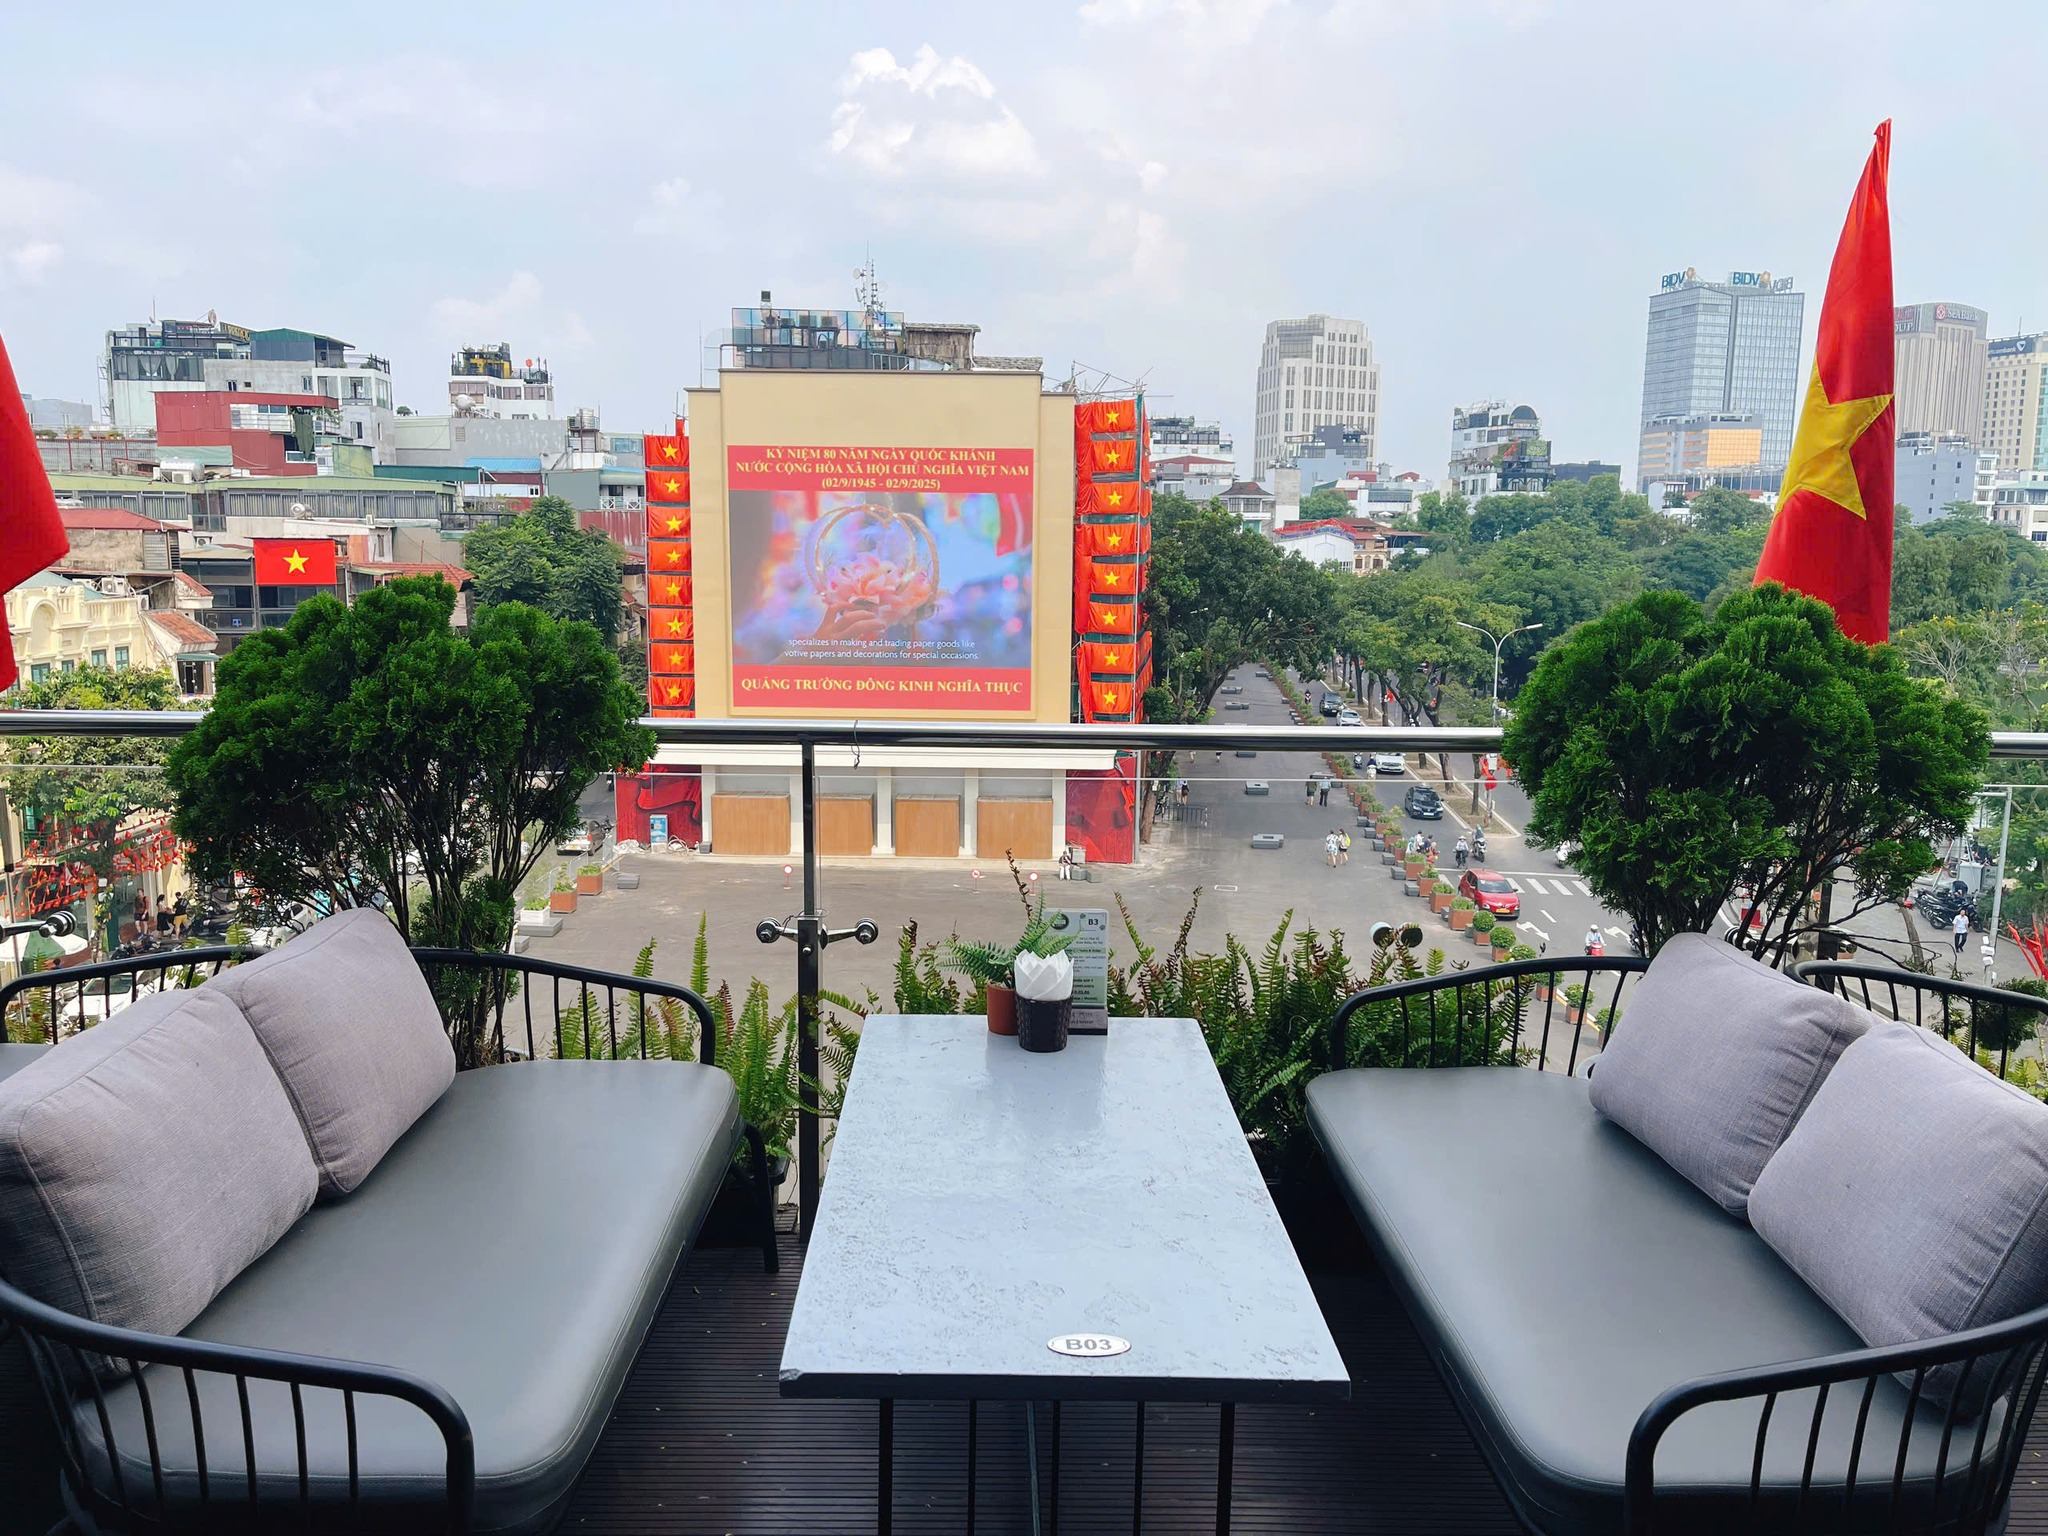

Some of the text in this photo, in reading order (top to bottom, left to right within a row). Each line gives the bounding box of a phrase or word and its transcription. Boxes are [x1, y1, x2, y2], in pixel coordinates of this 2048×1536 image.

[1661, 270, 1686, 289] BIDV
[1732, 271, 1760, 286] BIDV
[787, 447, 820, 461] NIỆM
[823, 448, 836, 459] 80
[839, 447, 868, 460] NĂM
[871, 447, 907, 460] NGÀY
[910, 448, 947, 463] QUỐC
[950, 448, 996, 461] KHÁNH
[736, 460, 772, 473] NƯỚC
[776, 461, 812, 475] CỘNG
[815, 460, 843, 474] HÒA
[846, 462, 863, 474] XÃ
[866, 462, 890, 476] HỘI
[923, 463, 964, 475] NGHĨA
[967, 464, 997, 478] VIỆT
[1000, 465, 1029, 476] NAM
[822, 478, 876, 489] (02/9/1945
[886, 478, 941, 490] 02/9/2025)
[788, 639, 830, 647] specializes
[840, 639, 867, 648] making
[869, 639, 883, 647] and
[885, 639, 912, 649] trading
[913, 641, 935, 649] paper
[937, 640, 960, 649] goods
[962, 640, 976, 648] like
[810, 652, 836, 660] papers
[837, 650, 852, 658] and
[853, 650, 898, 659] decorations
[900, 650, 912, 658] for
[913, 650, 940, 660] special
[794, 676, 852, 691] TRƯỜNG
[856, 677, 895, 692] ĐÔNG
[899, 680, 934, 692] KINH
[937, 679, 981, 693] NGHĨA
[985, 681, 1023, 695] THỤC
[1088, 918, 1099, 926] B3
[1066, 1339, 1112, 1350] B03
